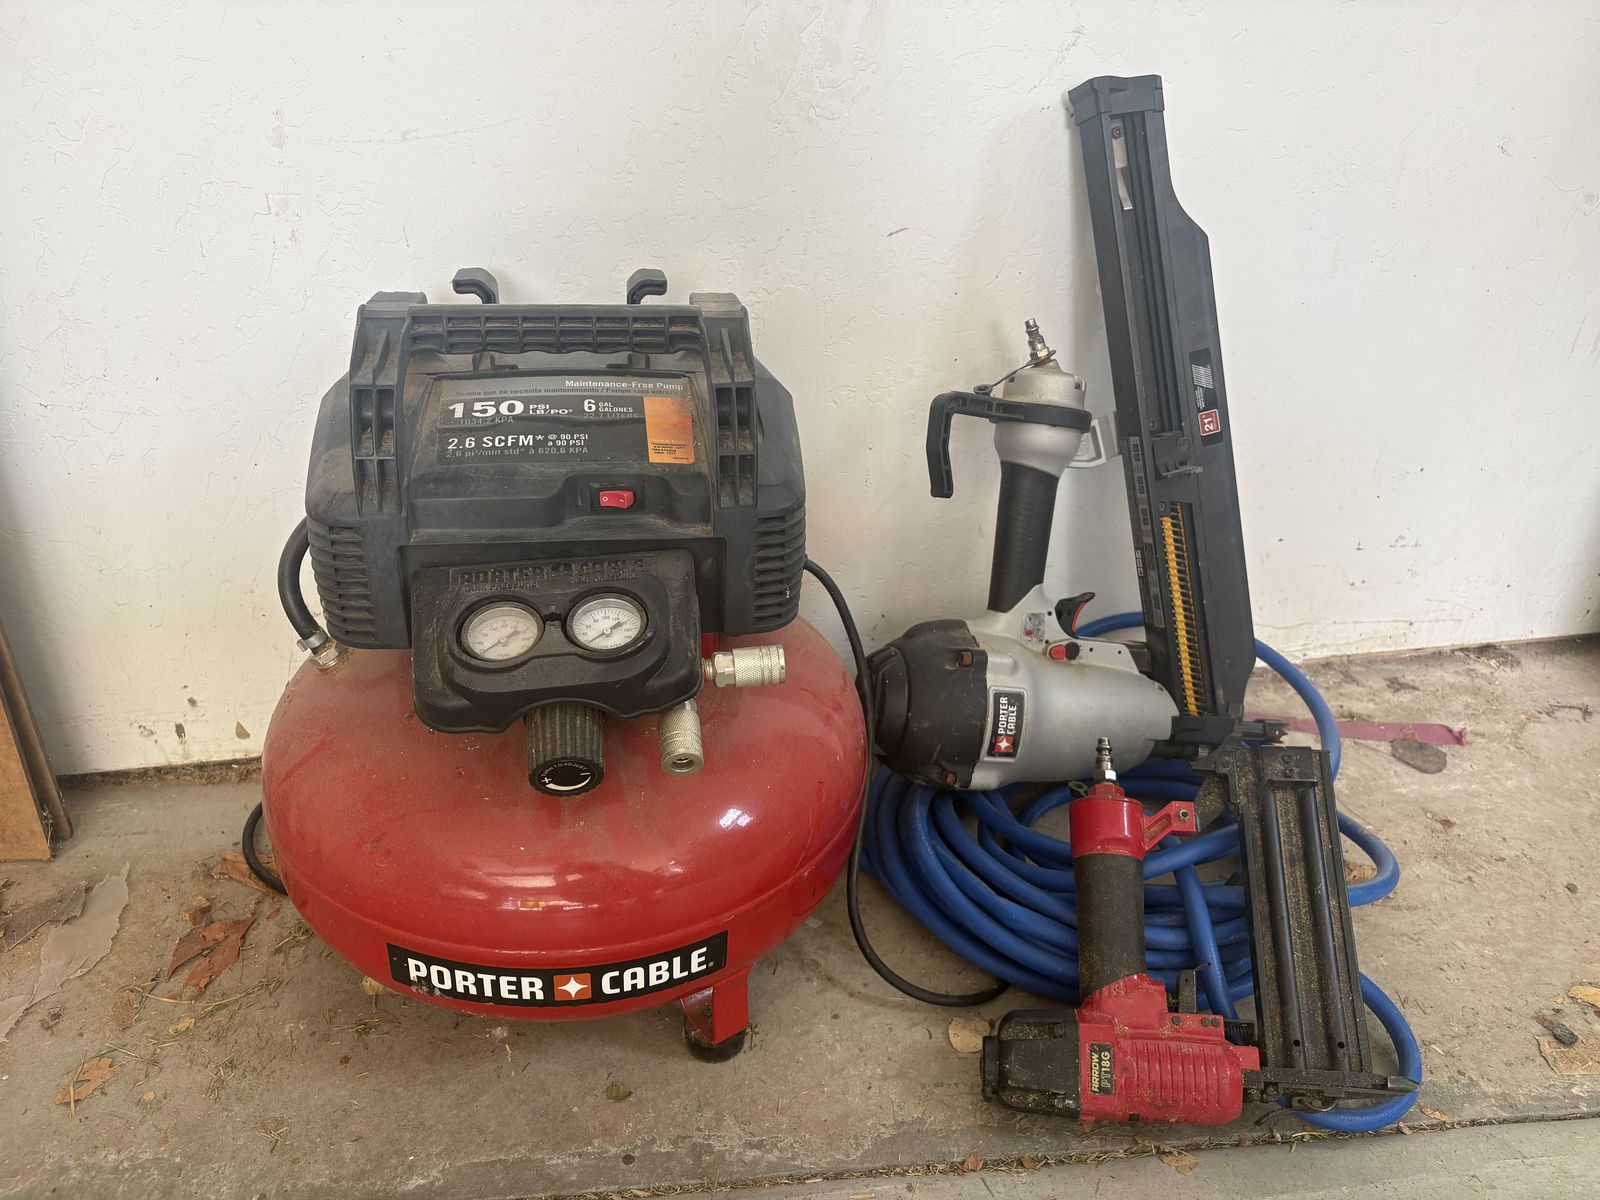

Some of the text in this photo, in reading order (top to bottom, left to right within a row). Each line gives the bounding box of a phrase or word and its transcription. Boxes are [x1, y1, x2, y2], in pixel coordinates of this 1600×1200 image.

[565, 380, 684, 391] Maintenance-Free Pump
[448, 400, 524, 418] 150
[583, 399, 596, 412] 6
[495, 416, 514, 424] KPA
[447, 437, 476, 449] 2.6
[997, 696, 1008, 734] PORTER
[1007, 705, 1017, 735] CABLE
[407, 947, 707, 1000] PORTER CABLE
[1091, 1051, 1100, 1092] ARROW
[1101, 1051, 1111, 1088] PT18G
